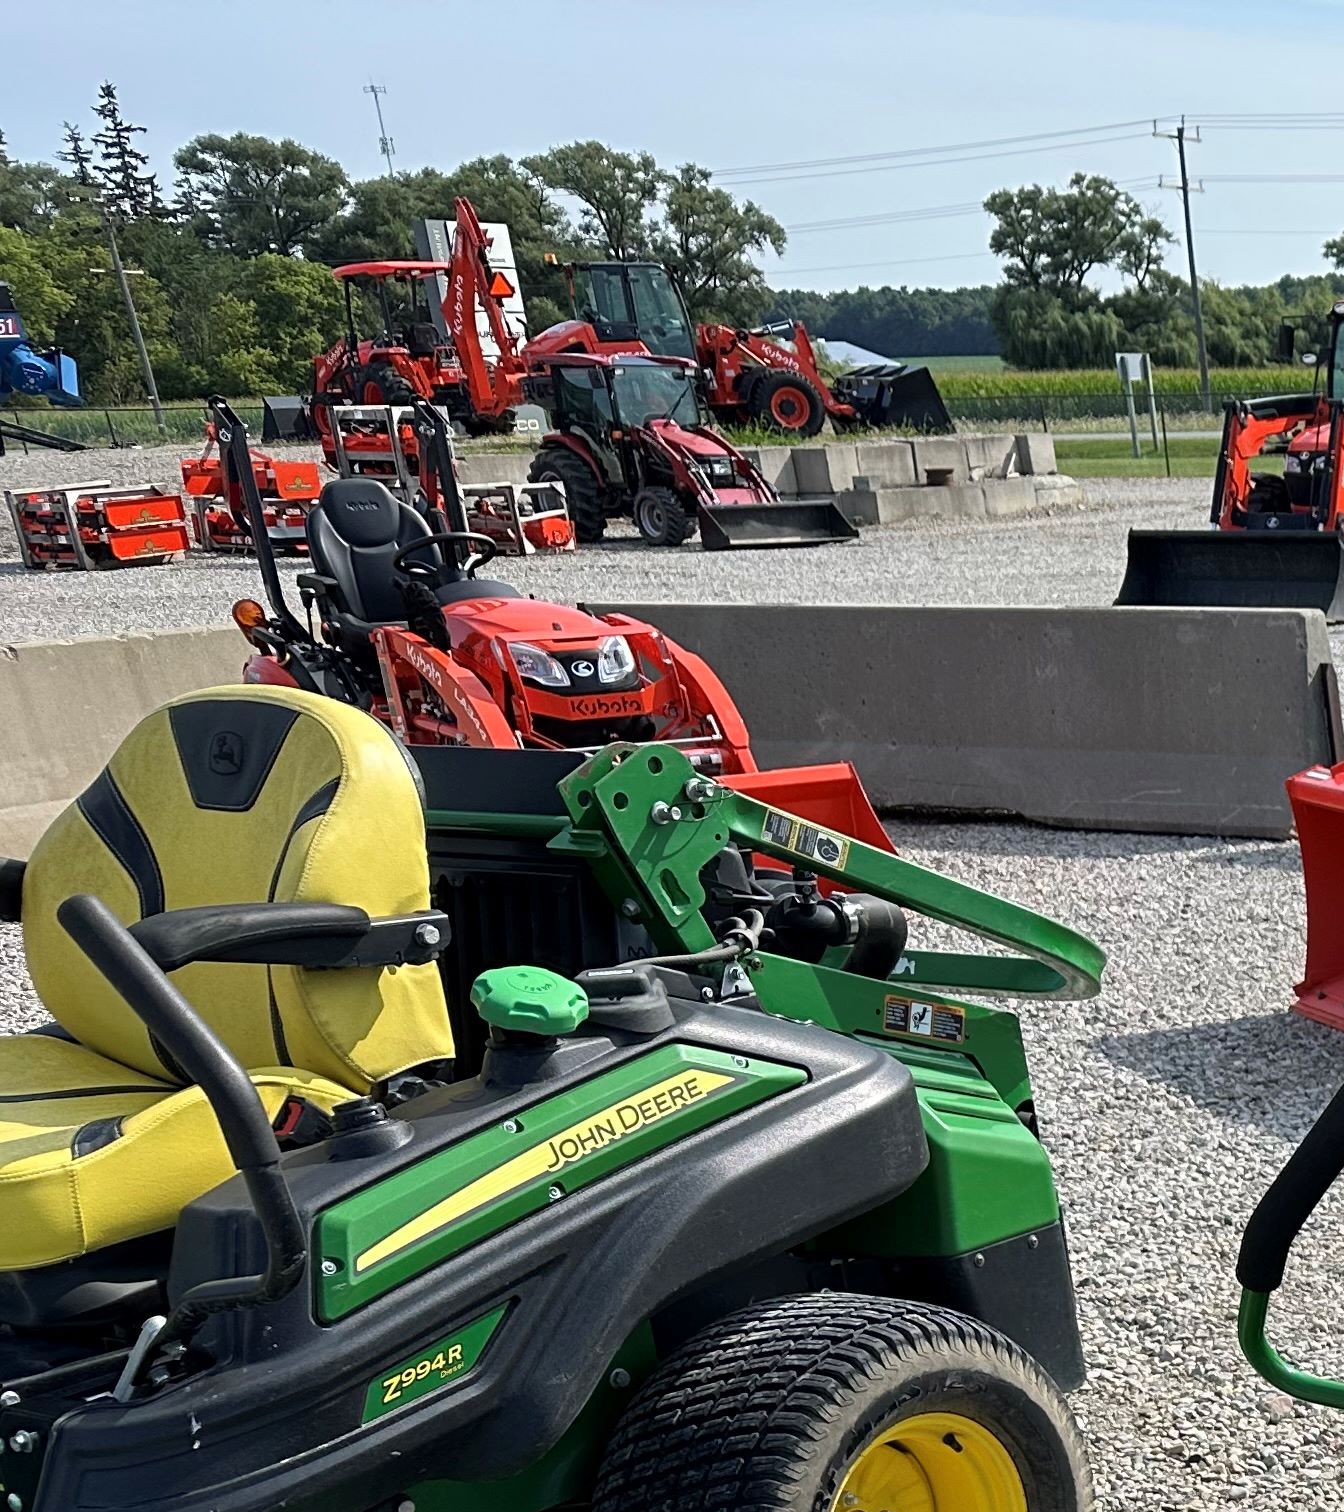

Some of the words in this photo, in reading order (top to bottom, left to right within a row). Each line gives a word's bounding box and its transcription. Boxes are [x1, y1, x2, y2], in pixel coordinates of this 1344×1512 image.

[761, 344, 800, 370] Kubota
[405, 642, 443, 688] Kubota
[452, 687, 488, 742] LA344
[569, 696, 643, 718] Kubota
[548, 1118, 616, 1171] JOHN
[617, 1076, 704, 1133] DEERE
